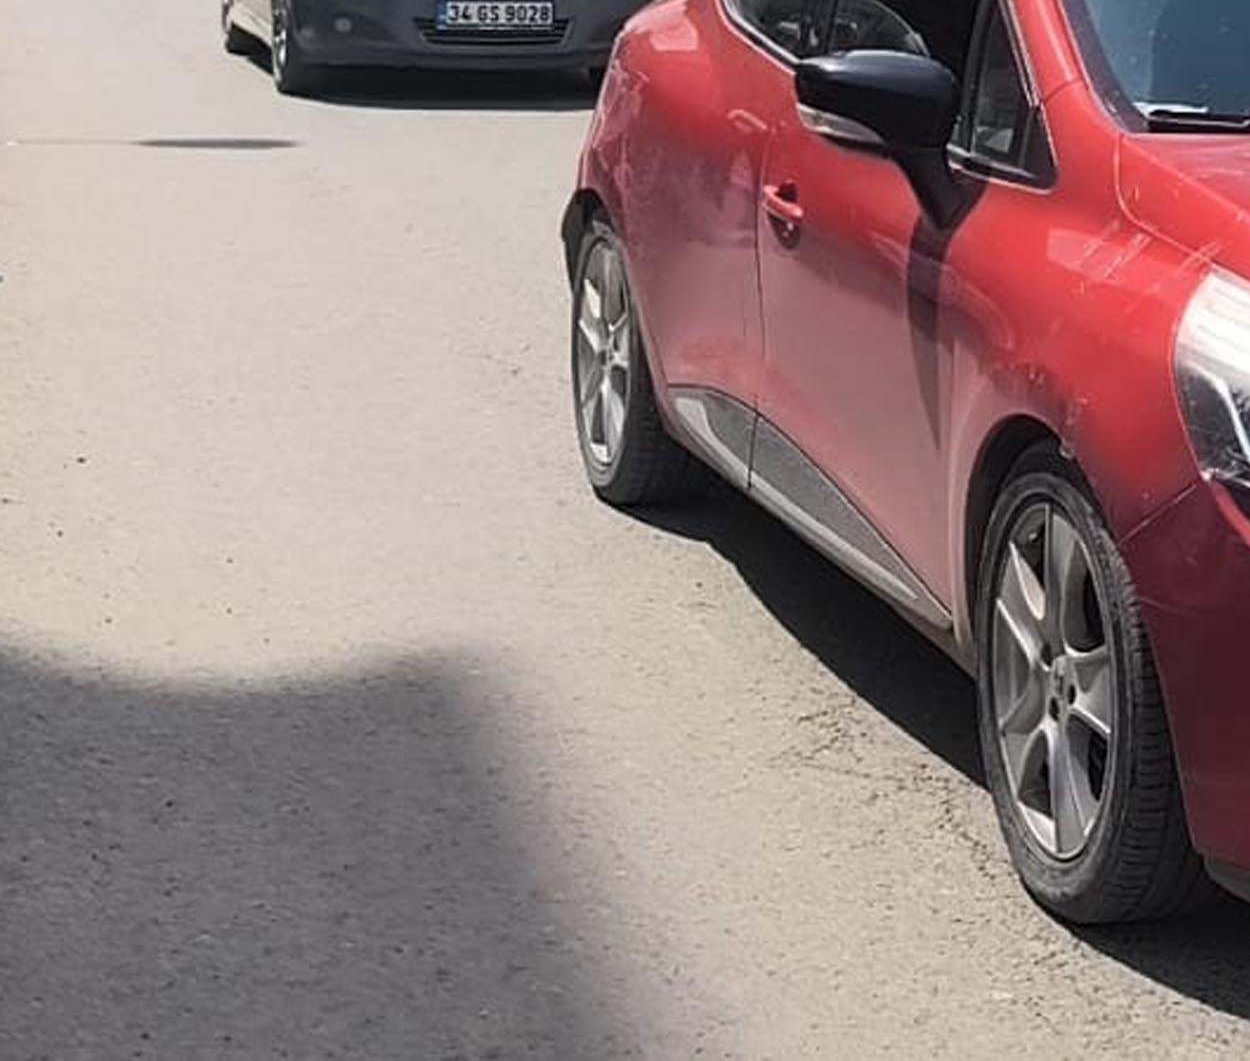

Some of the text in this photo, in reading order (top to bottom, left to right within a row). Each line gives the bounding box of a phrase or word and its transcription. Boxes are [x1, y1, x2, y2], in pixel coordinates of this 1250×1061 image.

[449, 5, 551, 20] 34 GS 9028
